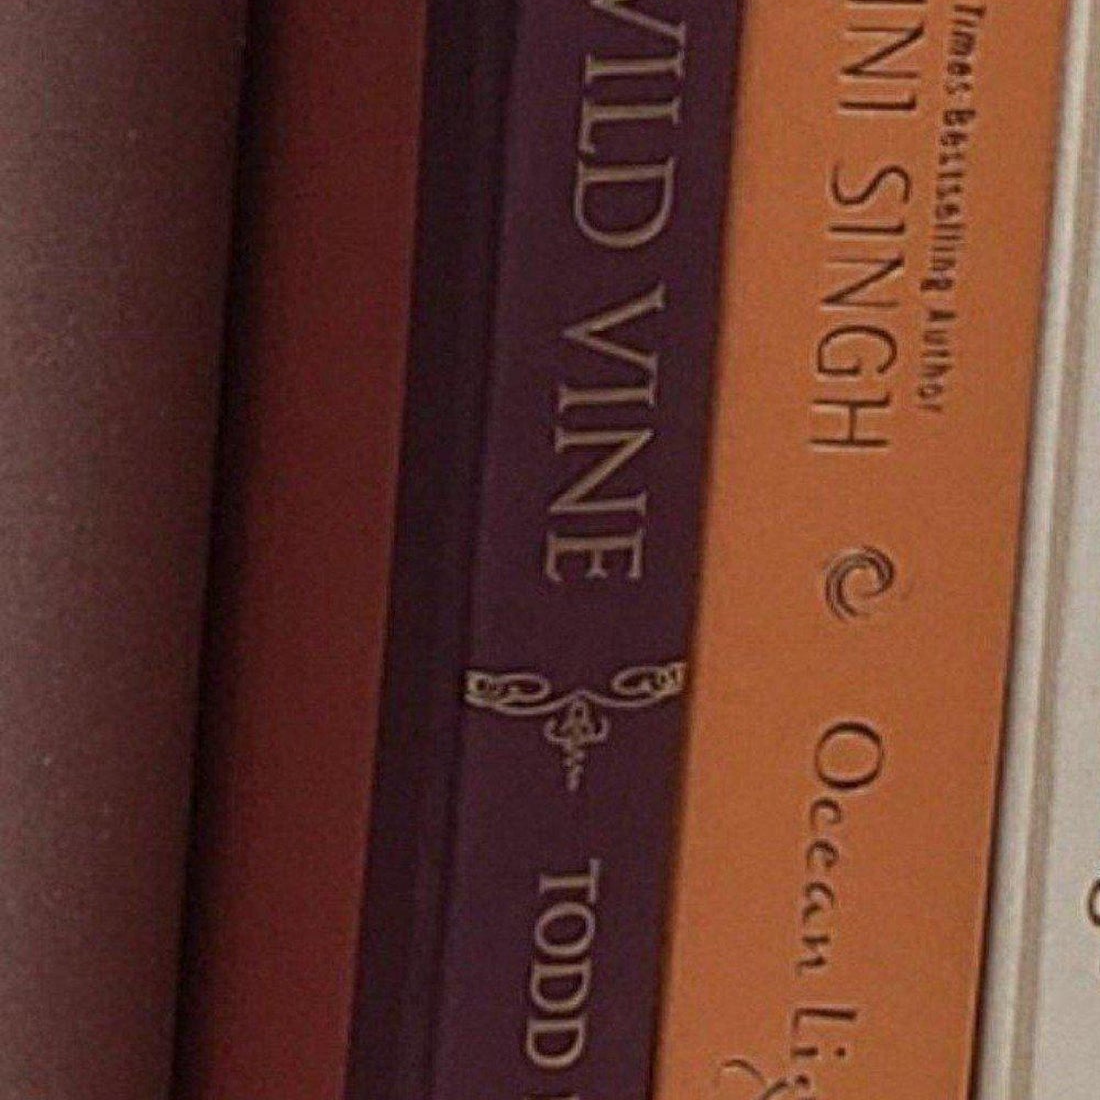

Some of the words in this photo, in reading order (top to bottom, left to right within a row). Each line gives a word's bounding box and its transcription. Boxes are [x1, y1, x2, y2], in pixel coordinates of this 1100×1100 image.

[943, 3, 987, 97] Times
[919, 108, 977, 291] Bestselling
[809, 162, 914, 449] SINGH
[916, 309, 958, 413] Author
[545, 283, 667, 585] VINE
[796, 720, 885, 978] Ocean
[526, 858, 602, 1068] TODD
